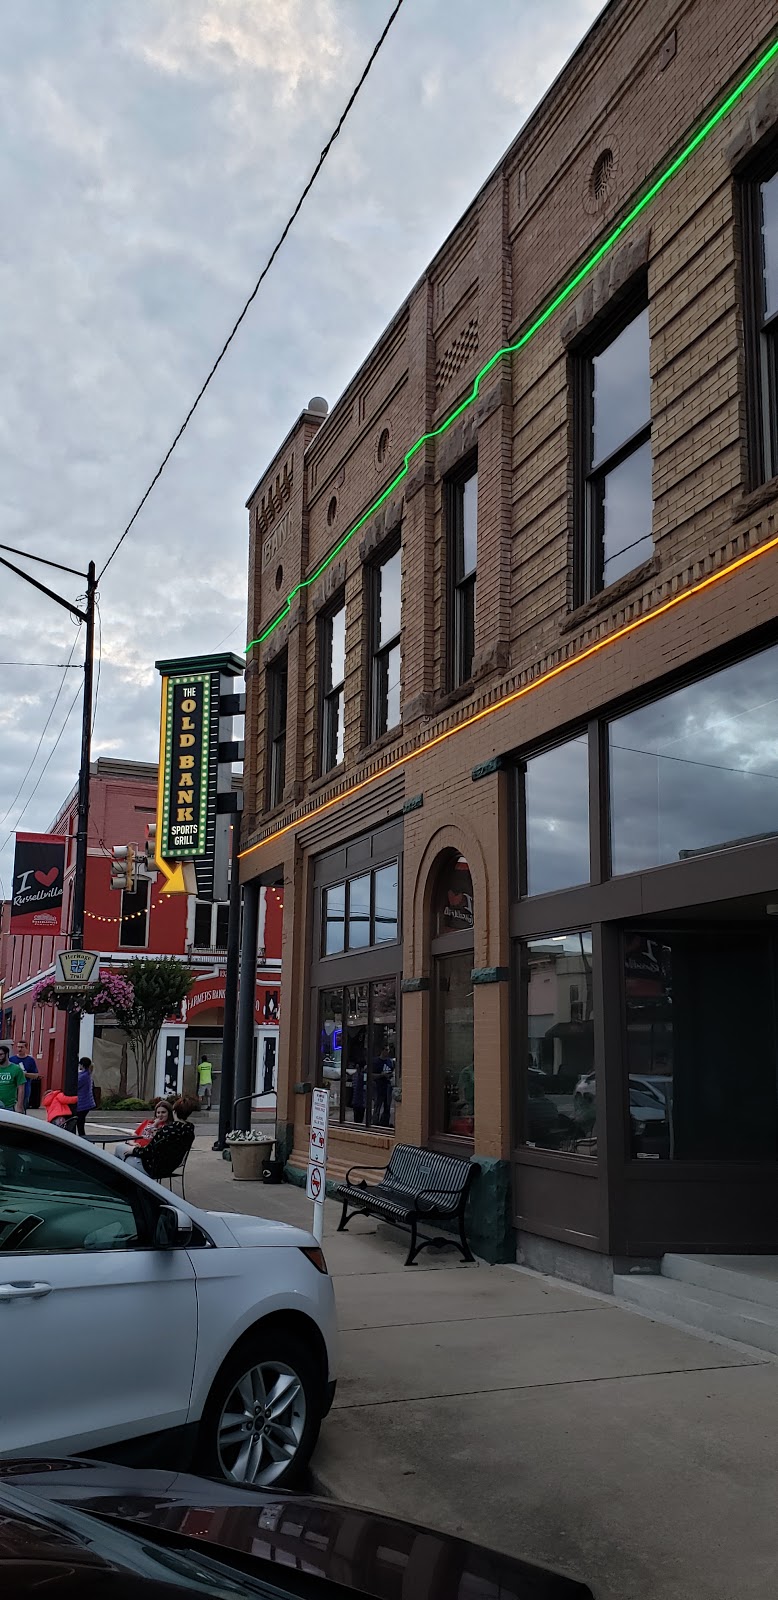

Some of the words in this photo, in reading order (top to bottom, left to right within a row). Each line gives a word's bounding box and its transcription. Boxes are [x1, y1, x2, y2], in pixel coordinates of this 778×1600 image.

[183, 687, 196, 697] THE
[180, 699, 196, 747] OLD
[177, 756, 194, 821] BANK
[171, 824, 198, 836] SPORTS
[174, 835, 194, 846] GRILL
[16, 870, 34, 895] I
[13, 886, 63, 906] Russellville
[65, 953, 91, 961] Heritage
[187, 990, 212, 1010] FARMERS
[212, 989, 226, 1000] BANK
